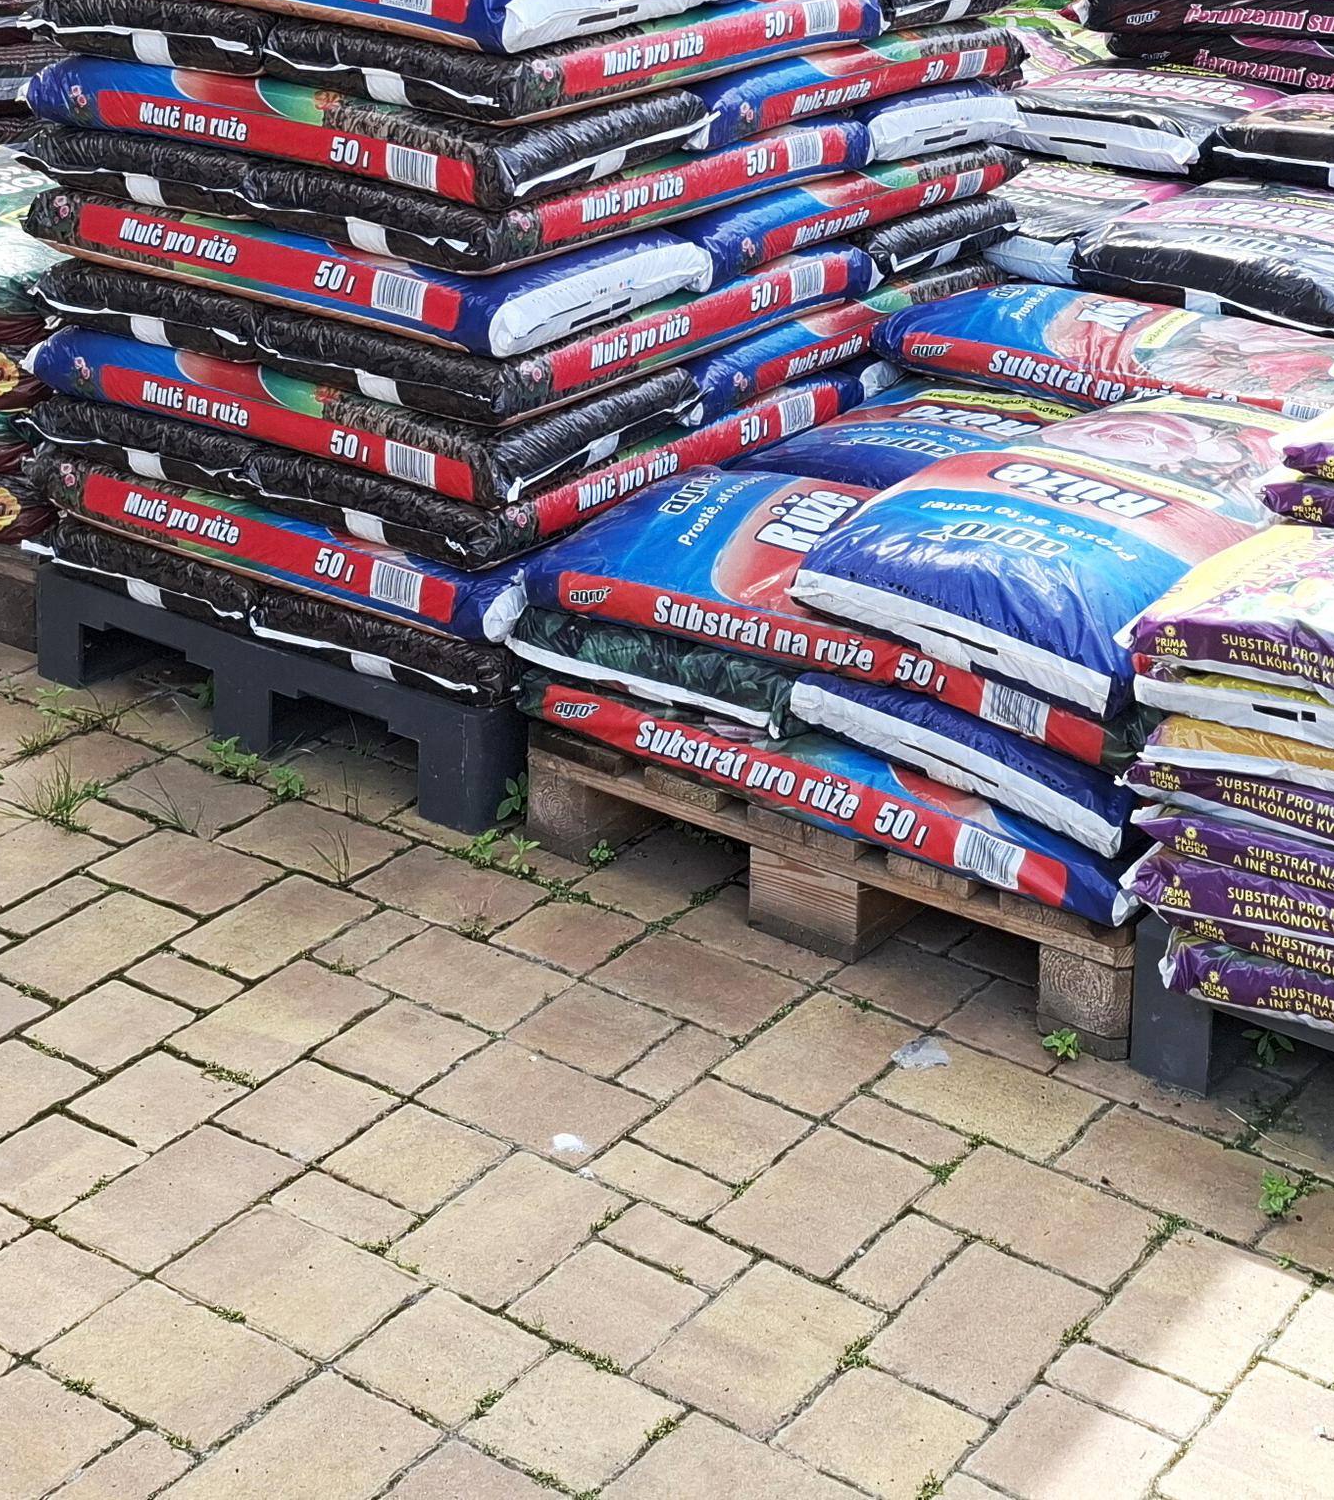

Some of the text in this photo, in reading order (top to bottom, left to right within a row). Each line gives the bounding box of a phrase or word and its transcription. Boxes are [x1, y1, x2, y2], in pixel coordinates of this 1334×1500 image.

[988, 463, 1169, 518] Růže
[569, 585, 605, 606] agro
[653, 594, 772, 649] Substrát
[772, 626, 809, 656] na
[815, 638, 875, 672] ruže
[893, 652, 934, 690] 50
[553, 699, 593, 720] agro
[636, 721, 751, 781] Substrát
[746, 756, 794, 796] pro
[799, 773, 861, 819] růže
[874, 801, 916, 841] 50
[1246, 845, 1319, 873] SUBSTRÁT
